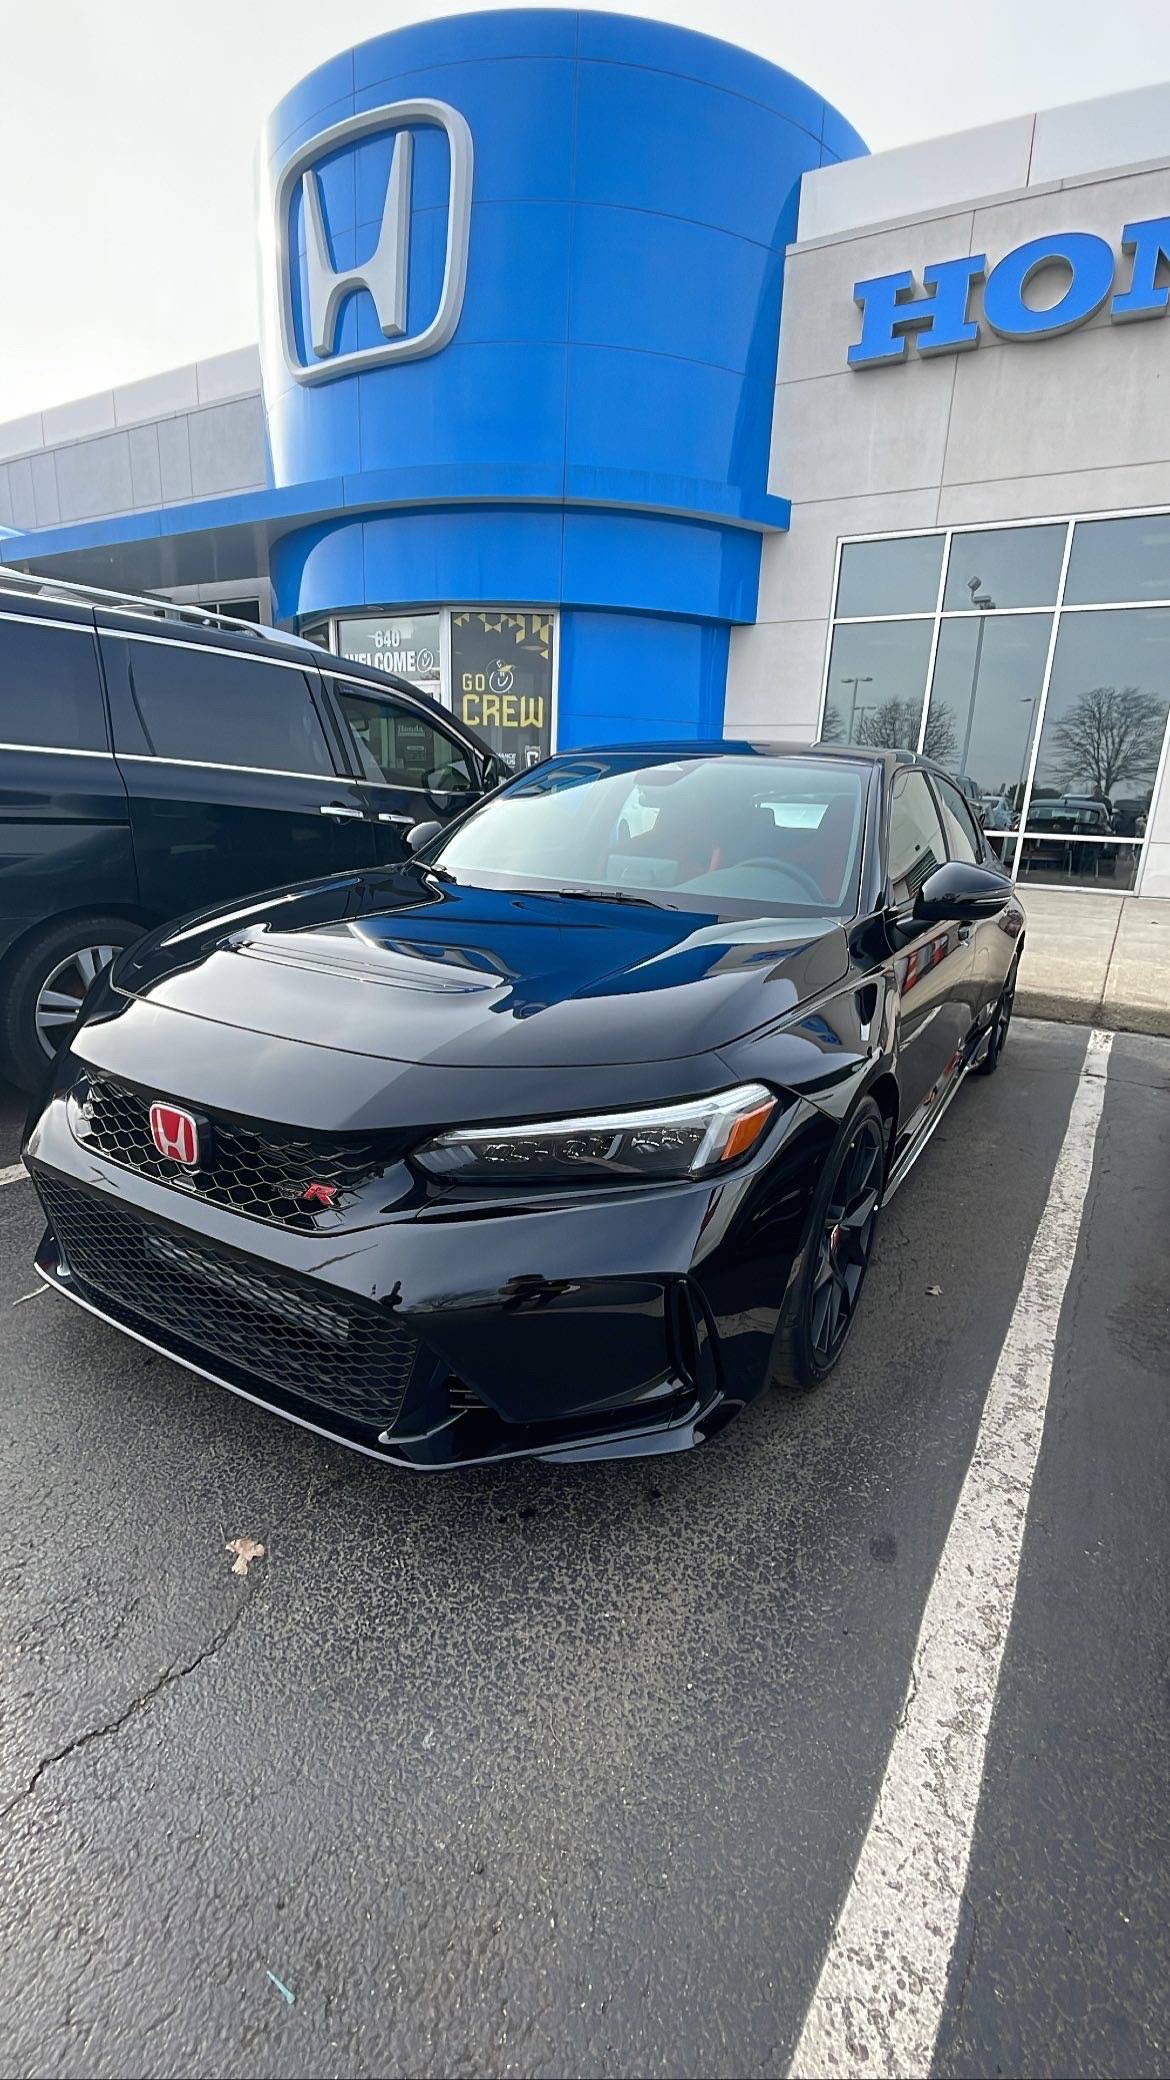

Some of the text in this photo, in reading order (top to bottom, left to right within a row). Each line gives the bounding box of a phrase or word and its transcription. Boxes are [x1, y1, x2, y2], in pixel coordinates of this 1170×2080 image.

[374, 630, 401, 648] 640
[462, 673, 485, 691] GO
[462, 694, 544, 728] CREW
